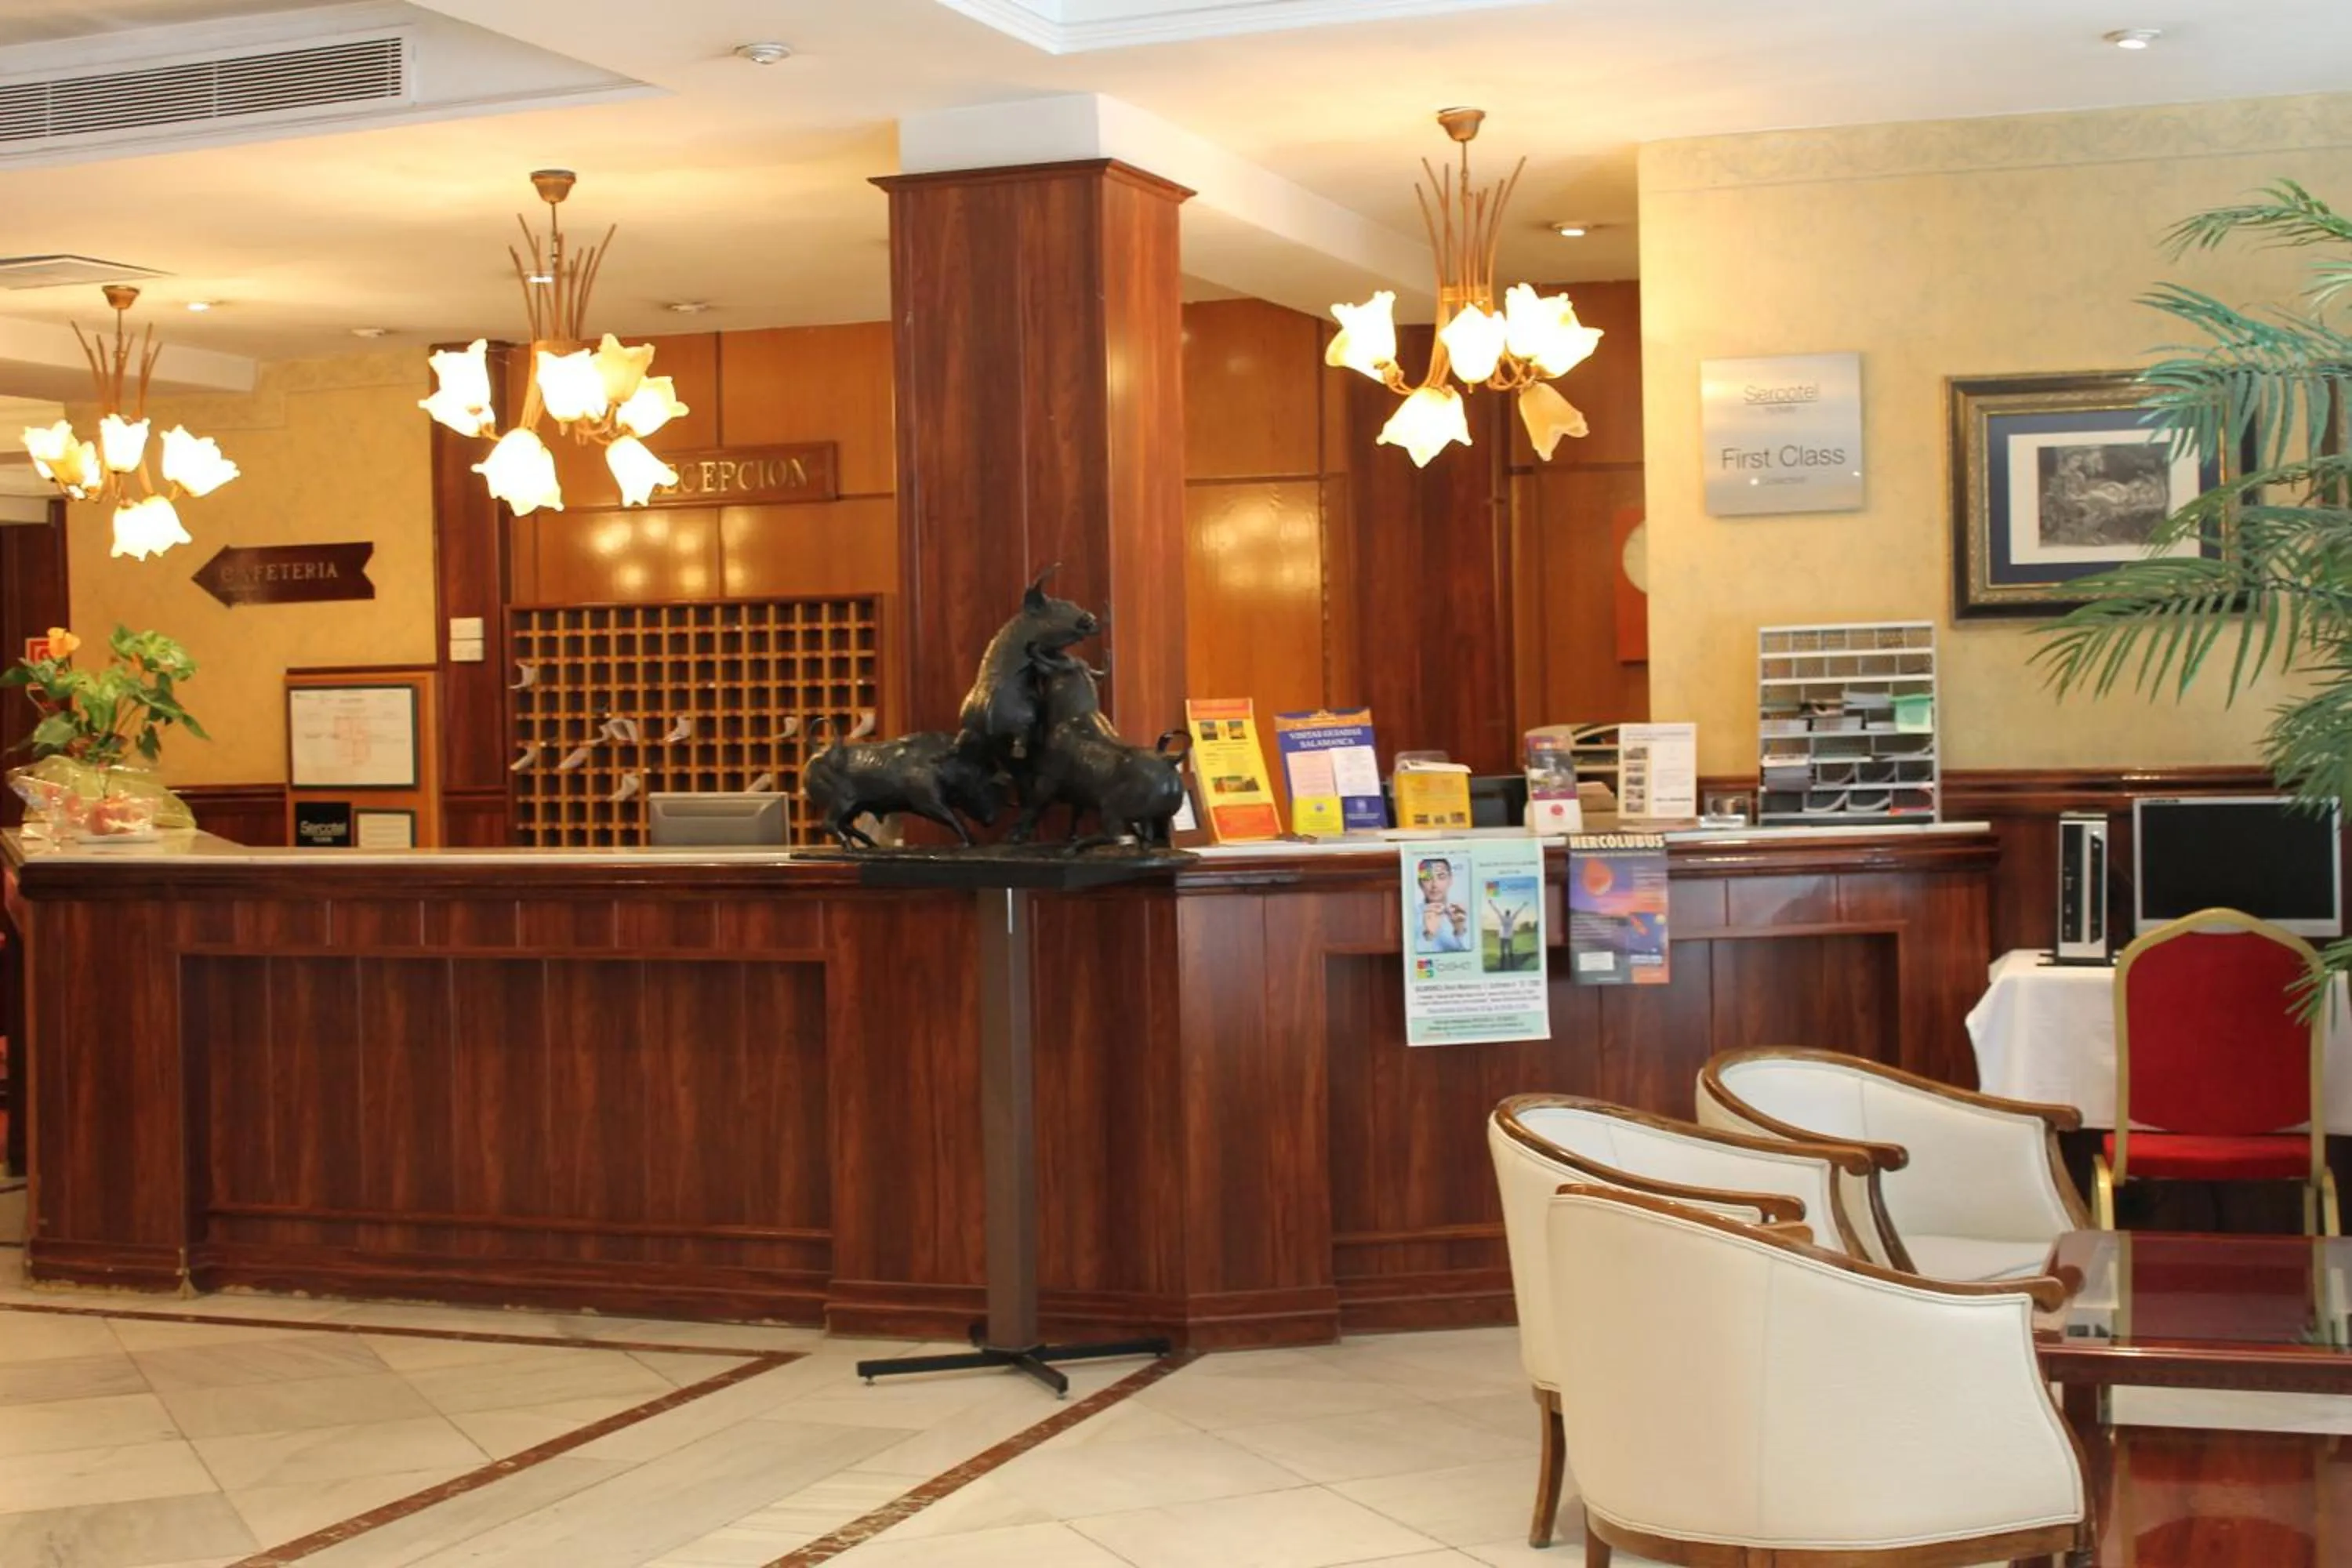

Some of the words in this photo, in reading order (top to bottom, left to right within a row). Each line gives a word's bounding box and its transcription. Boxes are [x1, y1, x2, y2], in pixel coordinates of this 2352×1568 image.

[1722, 448, 1772, 470] First
[1779, 445, 1846, 467] Class
[655, 458, 808, 494] CEPCION
[220, 562, 339, 582] CAFETERIA
[1569, 833, 1665, 849] HERCOLUBUS
